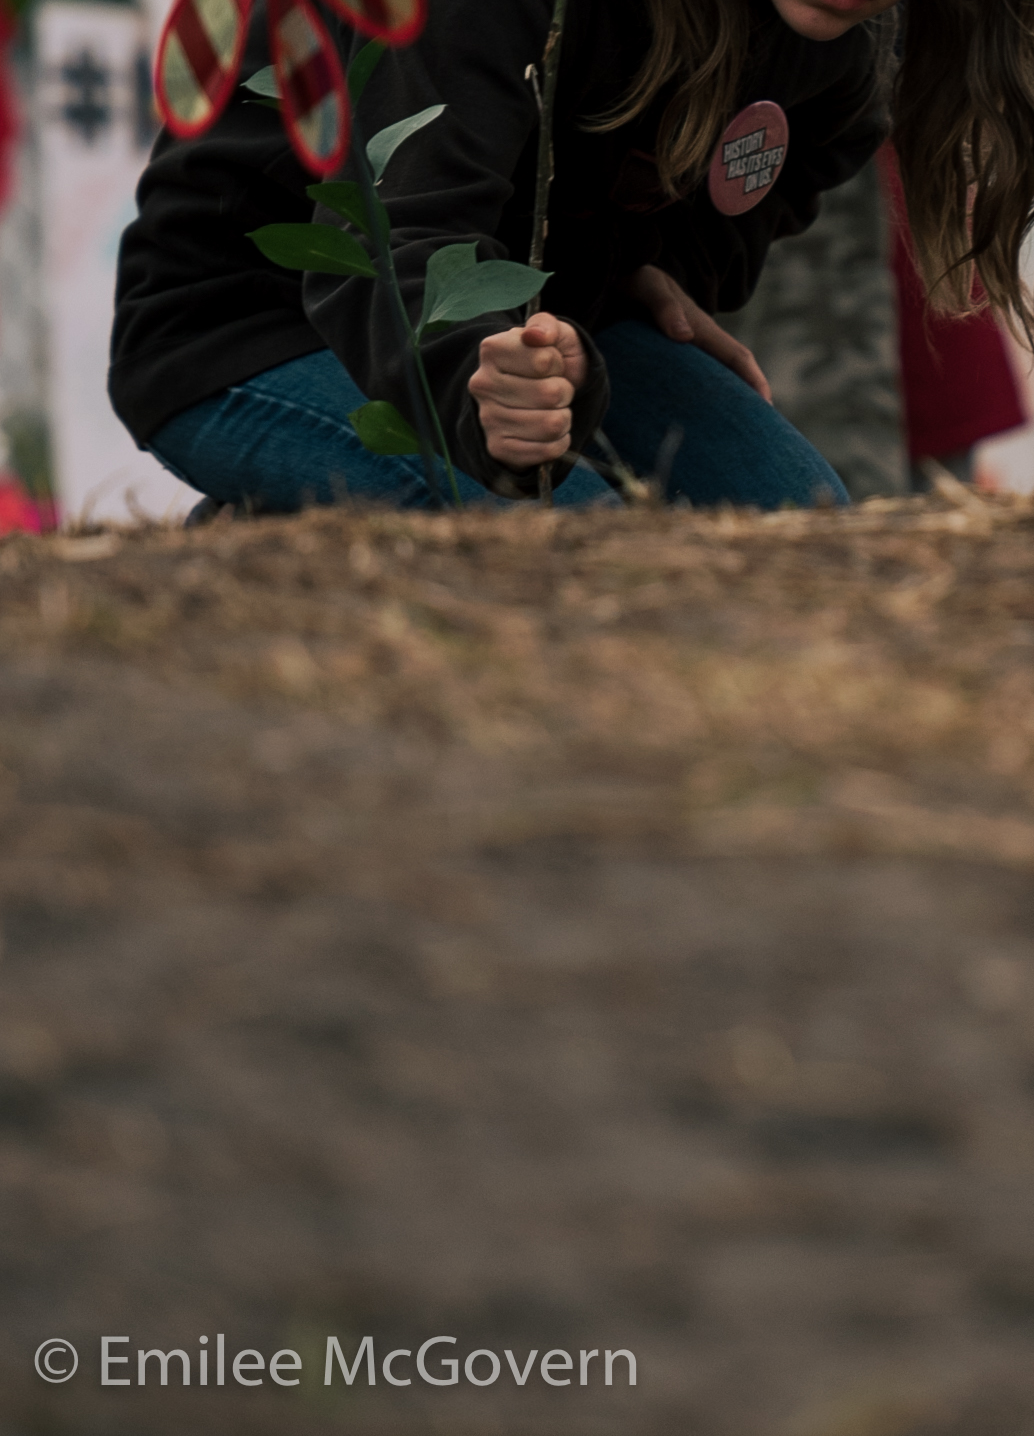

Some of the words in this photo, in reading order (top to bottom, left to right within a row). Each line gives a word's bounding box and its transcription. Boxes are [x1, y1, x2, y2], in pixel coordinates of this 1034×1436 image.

[724, 129, 765, 163] HISTORY
[727, 157, 747, 179] HAS
[747, 152, 762, 173] ITS
[762, 146, 784, 168] EYES
[745, 173, 758, 193] ON
